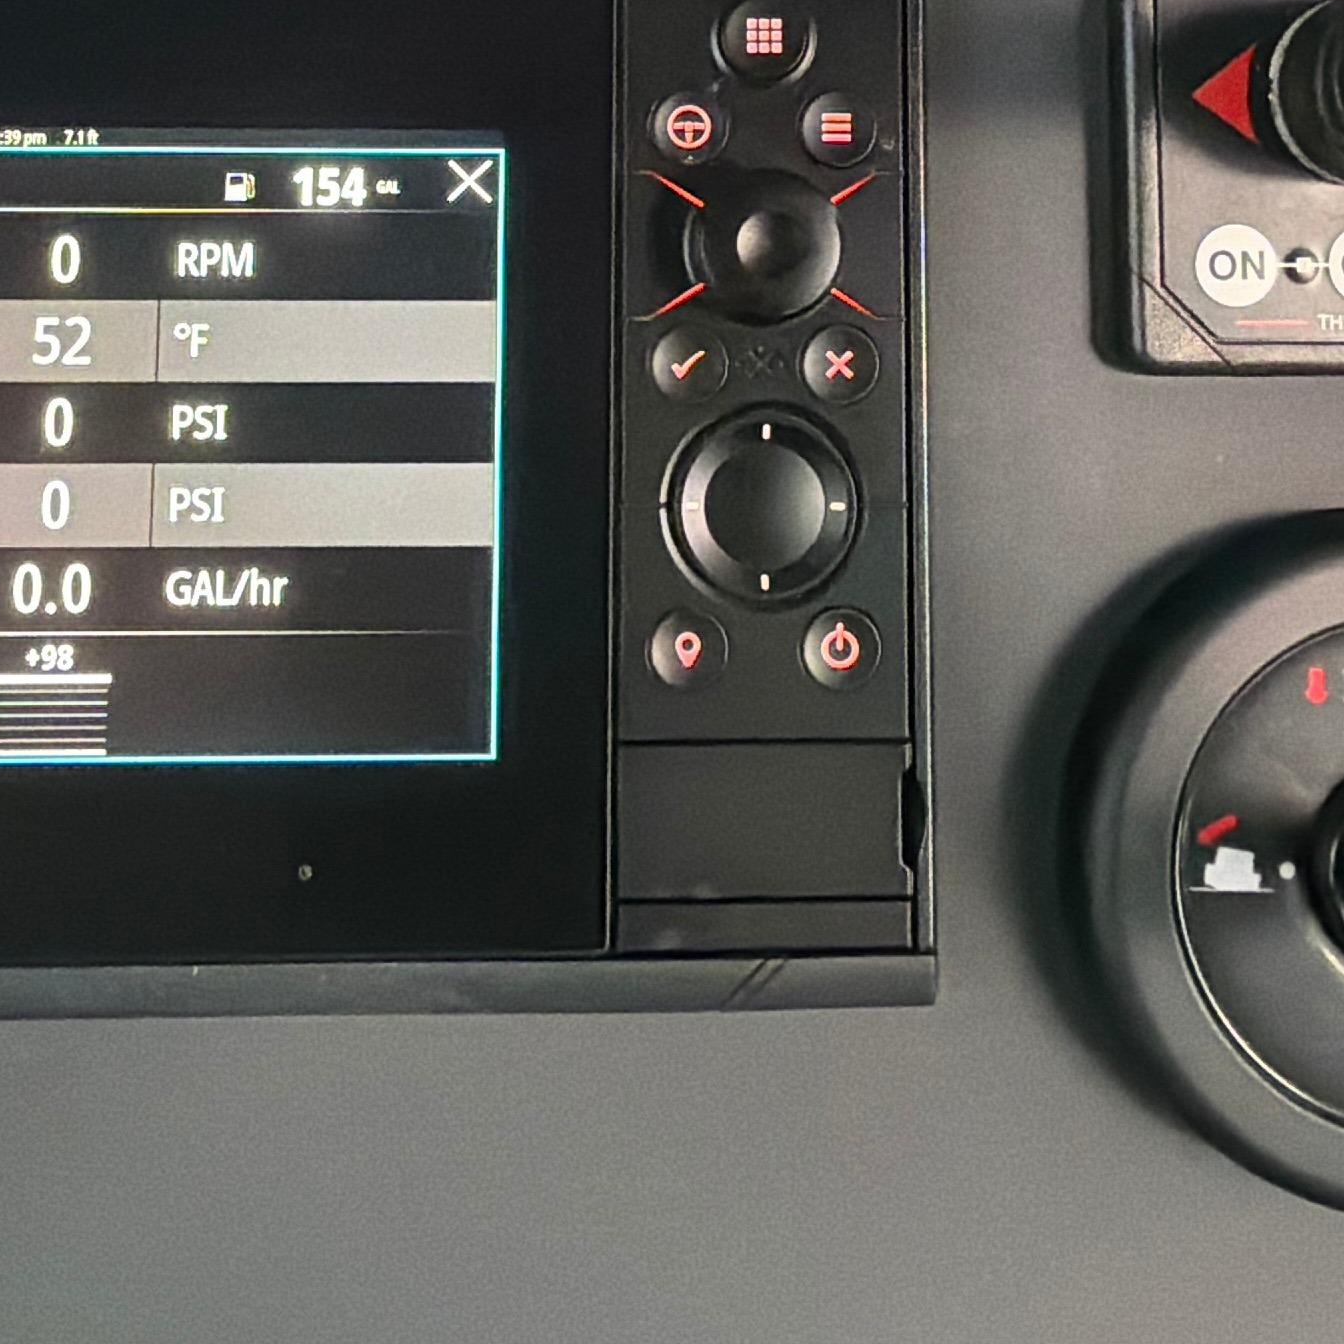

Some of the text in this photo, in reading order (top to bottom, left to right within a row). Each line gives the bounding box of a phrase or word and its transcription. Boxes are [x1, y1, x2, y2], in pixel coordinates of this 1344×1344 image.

[23, 132, 47, 148] pm
[64, 129, 100, 146] 7.1 ft
[293, 166, 400, 207] 154 GAL
[50, 233, 81, 285] 0
[177, 241, 255, 278] RPM
[1208, 250, 1266, 281] ON
[31, 316, 92, 366] 52
[43, 396, 74, 448] 0
[171, 404, 229, 440] PSI
[40, 479, 71, 530] 0
[168, 486, 226, 524] PSI
[11, 561, 93, 616] 0.0
[165, 569, 289, 609] GAL/hr
[24, 644, 74, 672] +98
